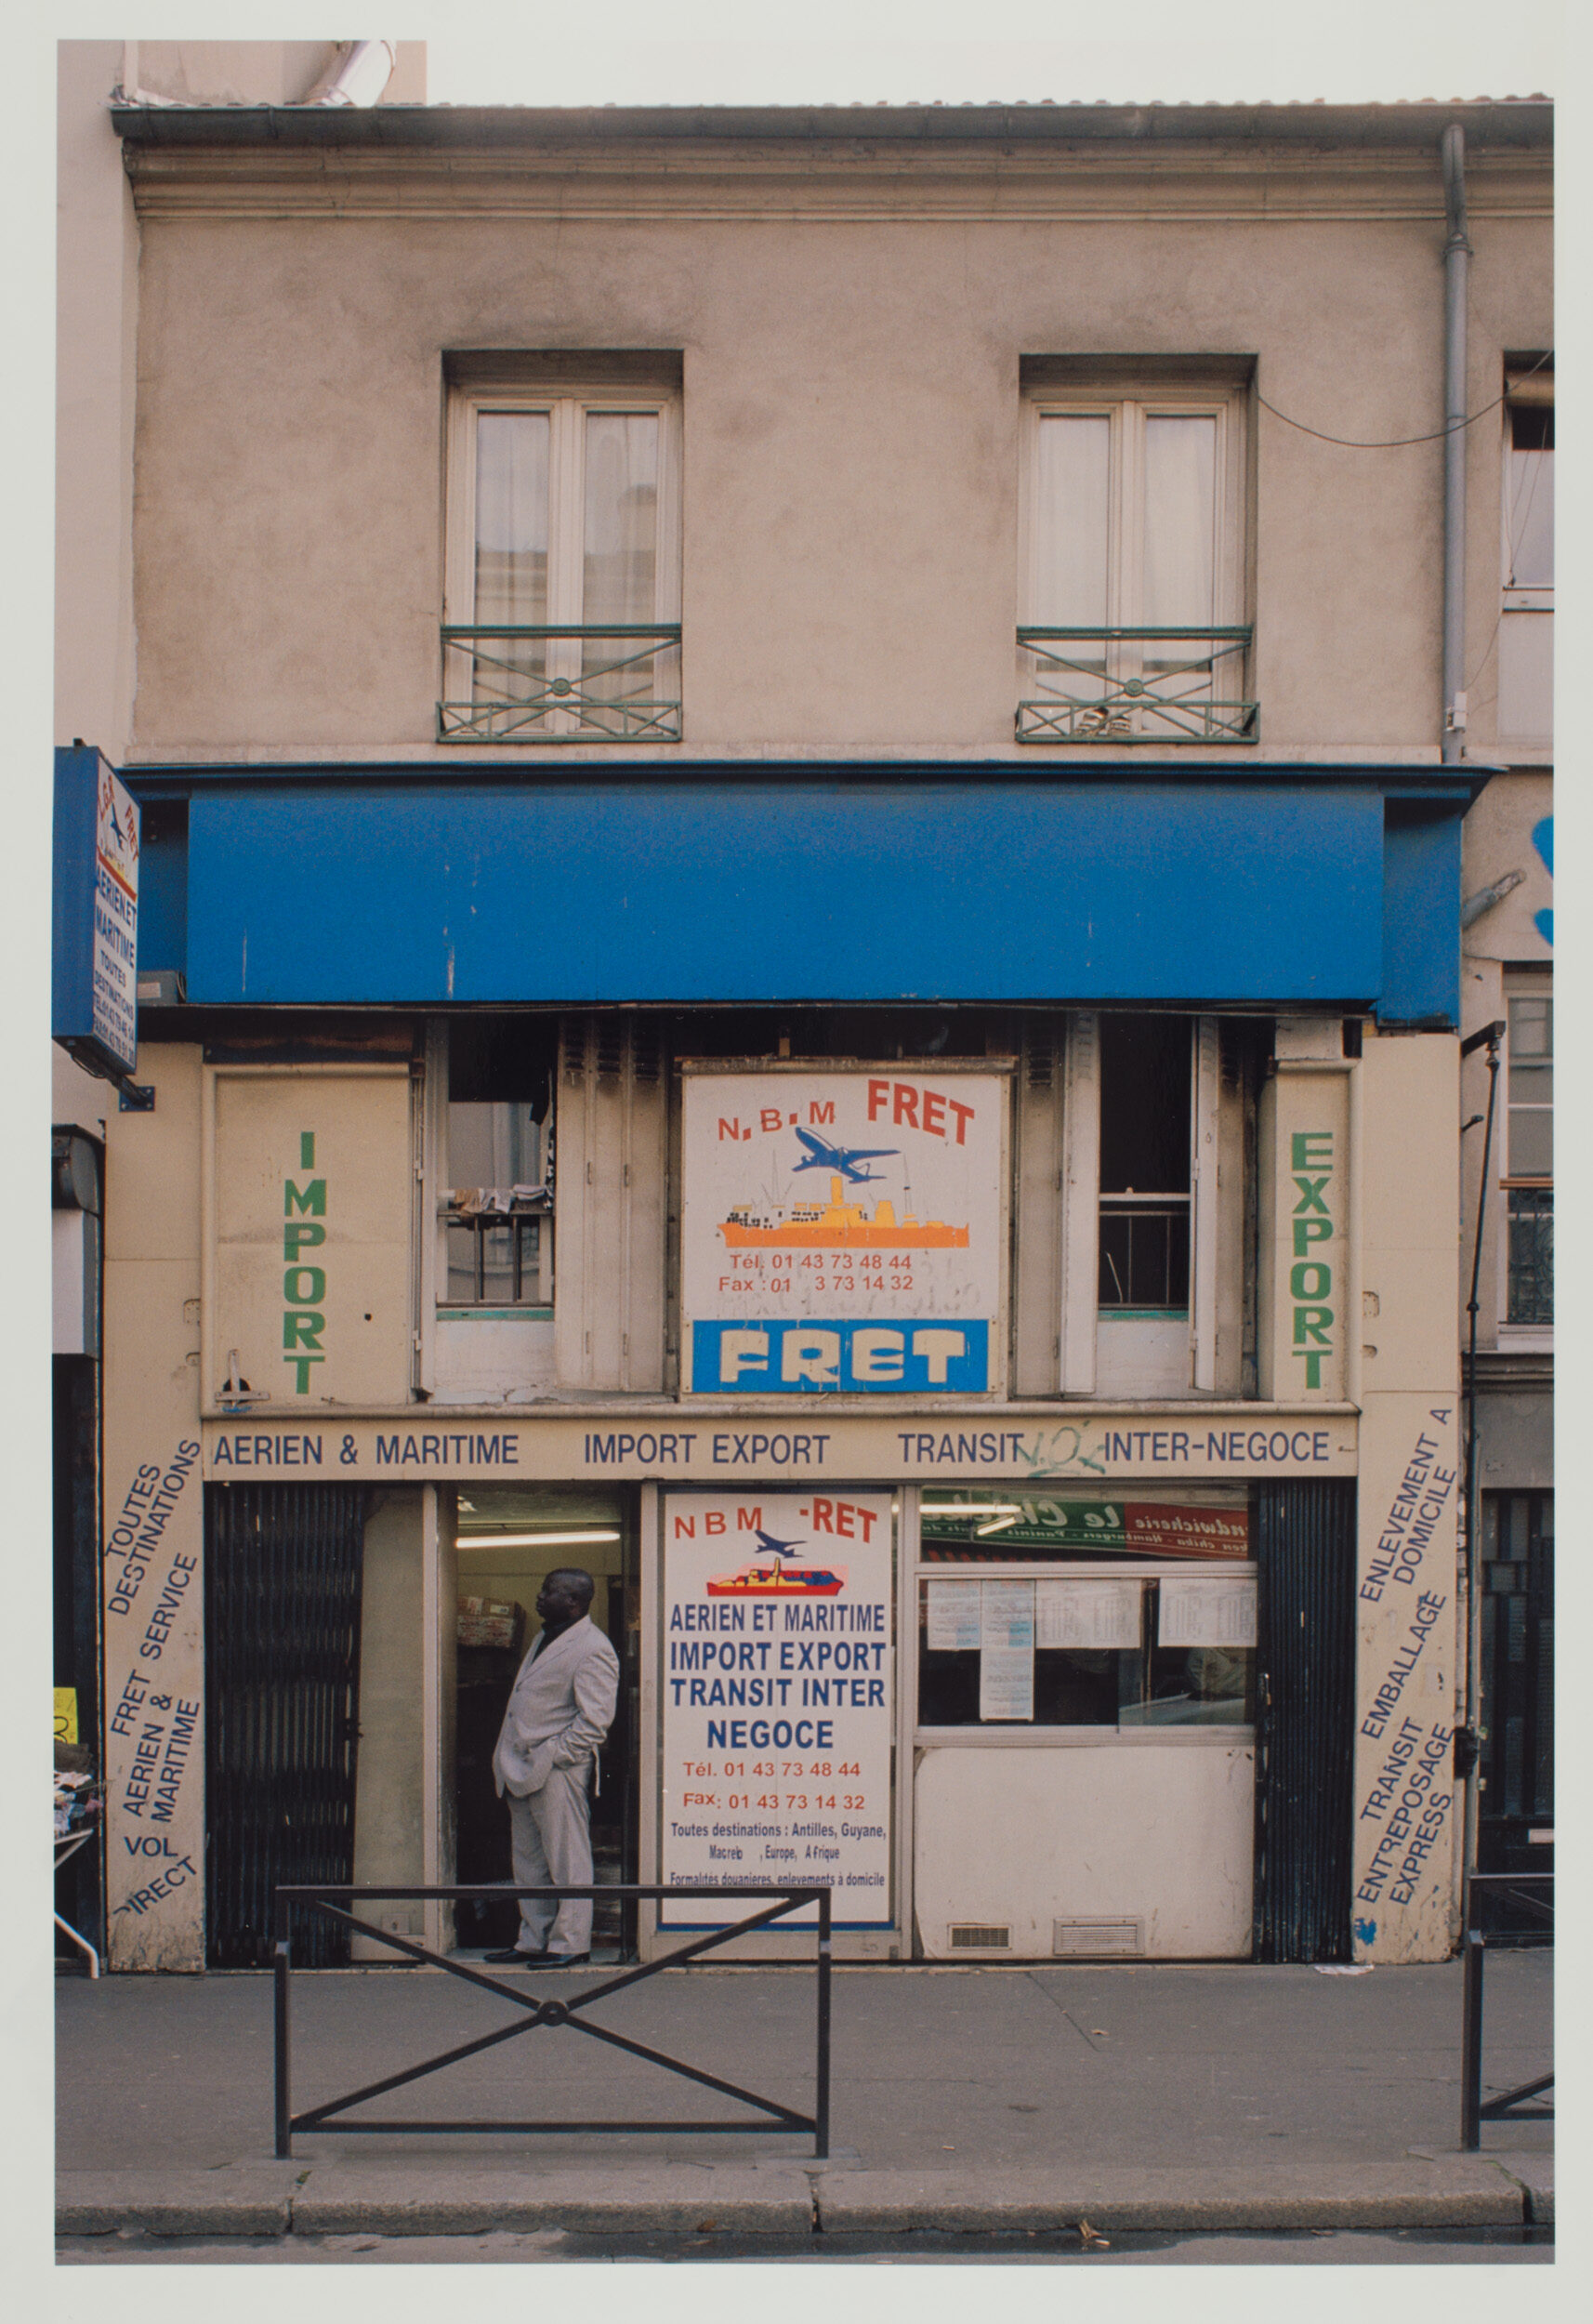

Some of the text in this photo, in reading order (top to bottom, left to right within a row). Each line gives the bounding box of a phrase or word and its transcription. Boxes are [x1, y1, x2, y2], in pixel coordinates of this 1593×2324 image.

[124, 803, 139, 862] FRET
[96, 904, 135, 970] MARITIME
[94, 969, 135, 1022] DESTINATIONS
[100, 949, 126, 989] TOUTES
[868, 1078, 975, 1146] FRET
[283, 1131, 326, 1394] IMPORT
[730, 1254, 912, 1269] Tél. 01 43 73 48 44
[833, 1276, 855, 1290] 73
[862, 1275, 884, 1290] 14
[891, 1275, 914, 1290] 32
[1290, 1132, 1334, 1390] EXPORT
[719, 1329, 965, 1383] FRET
[214, 1434, 323, 1465] AERIEN
[339, 1434, 359, 1465] &
[376, 1434, 519, 1465] MARITIME
[585, 1433, 697, 1464] IMPORT
[713, 1433, 830, 1464] EXPORT
[898, 1433, 1024, 1463] TRANSIT
[1104, 1431, 1330, 1462] INTER-NEGOCE
[104, 1463, 161, 1559] TOUTES
[108, 1439, 201, 1616] DESTINATIONS
[799, 1497, 877, 1544] RET
[1359, 1408, 1452, 1603] ENLEVEMENT A
[1392, 1465, 1457, 1586] DOMICILE
[111, 1552, 197, 1736] FRET SERVICE
[670, 1604, 885, 1632] AERIEN ET MARITIME
[670, 1642, 887, 1670] IMPORT EXPORT
[1362, 1591, 1447, 1740] EMBALLAGE
[670, 1678, 885, 1707] TRANSIT INTER
[123, 1695, 173, 1817] AERIEN &
[151, 1699, 200, 1823] MARITIME
[707, 1720, 834, 1749] NEGOCE
[683, 1762, 861, 1776] Tél. 01 43 73 48 44
[1360, 1716, 1424, 1825] TRANSIT
[729, 1795, 749, 1809] 01
[757, 1795, 779, 1809] 43
[786, 1795, 808, 1809] 73
[815, 1795, 836, 1809] 14
[843, 1795, 865, 1809] 32
[1357, 1723, 1455, 1904] ENTREPOSAGE
[124, 1836, 178, 1857] VOL
[671, 1822, 708, 1837] Toutes
[712, 1822, 782, 1837] destinations
[791, 1822, 837, 1840] Antilles,
[841, 1822, 887, 1841] Guyane,
[765, 1844, 797, 1863] Europe,
[1389, 1792, 1452, 1907] EXPRESS
[837, 1870, 844, 1885] à
[846, 1870, 885, 1886] domicile
